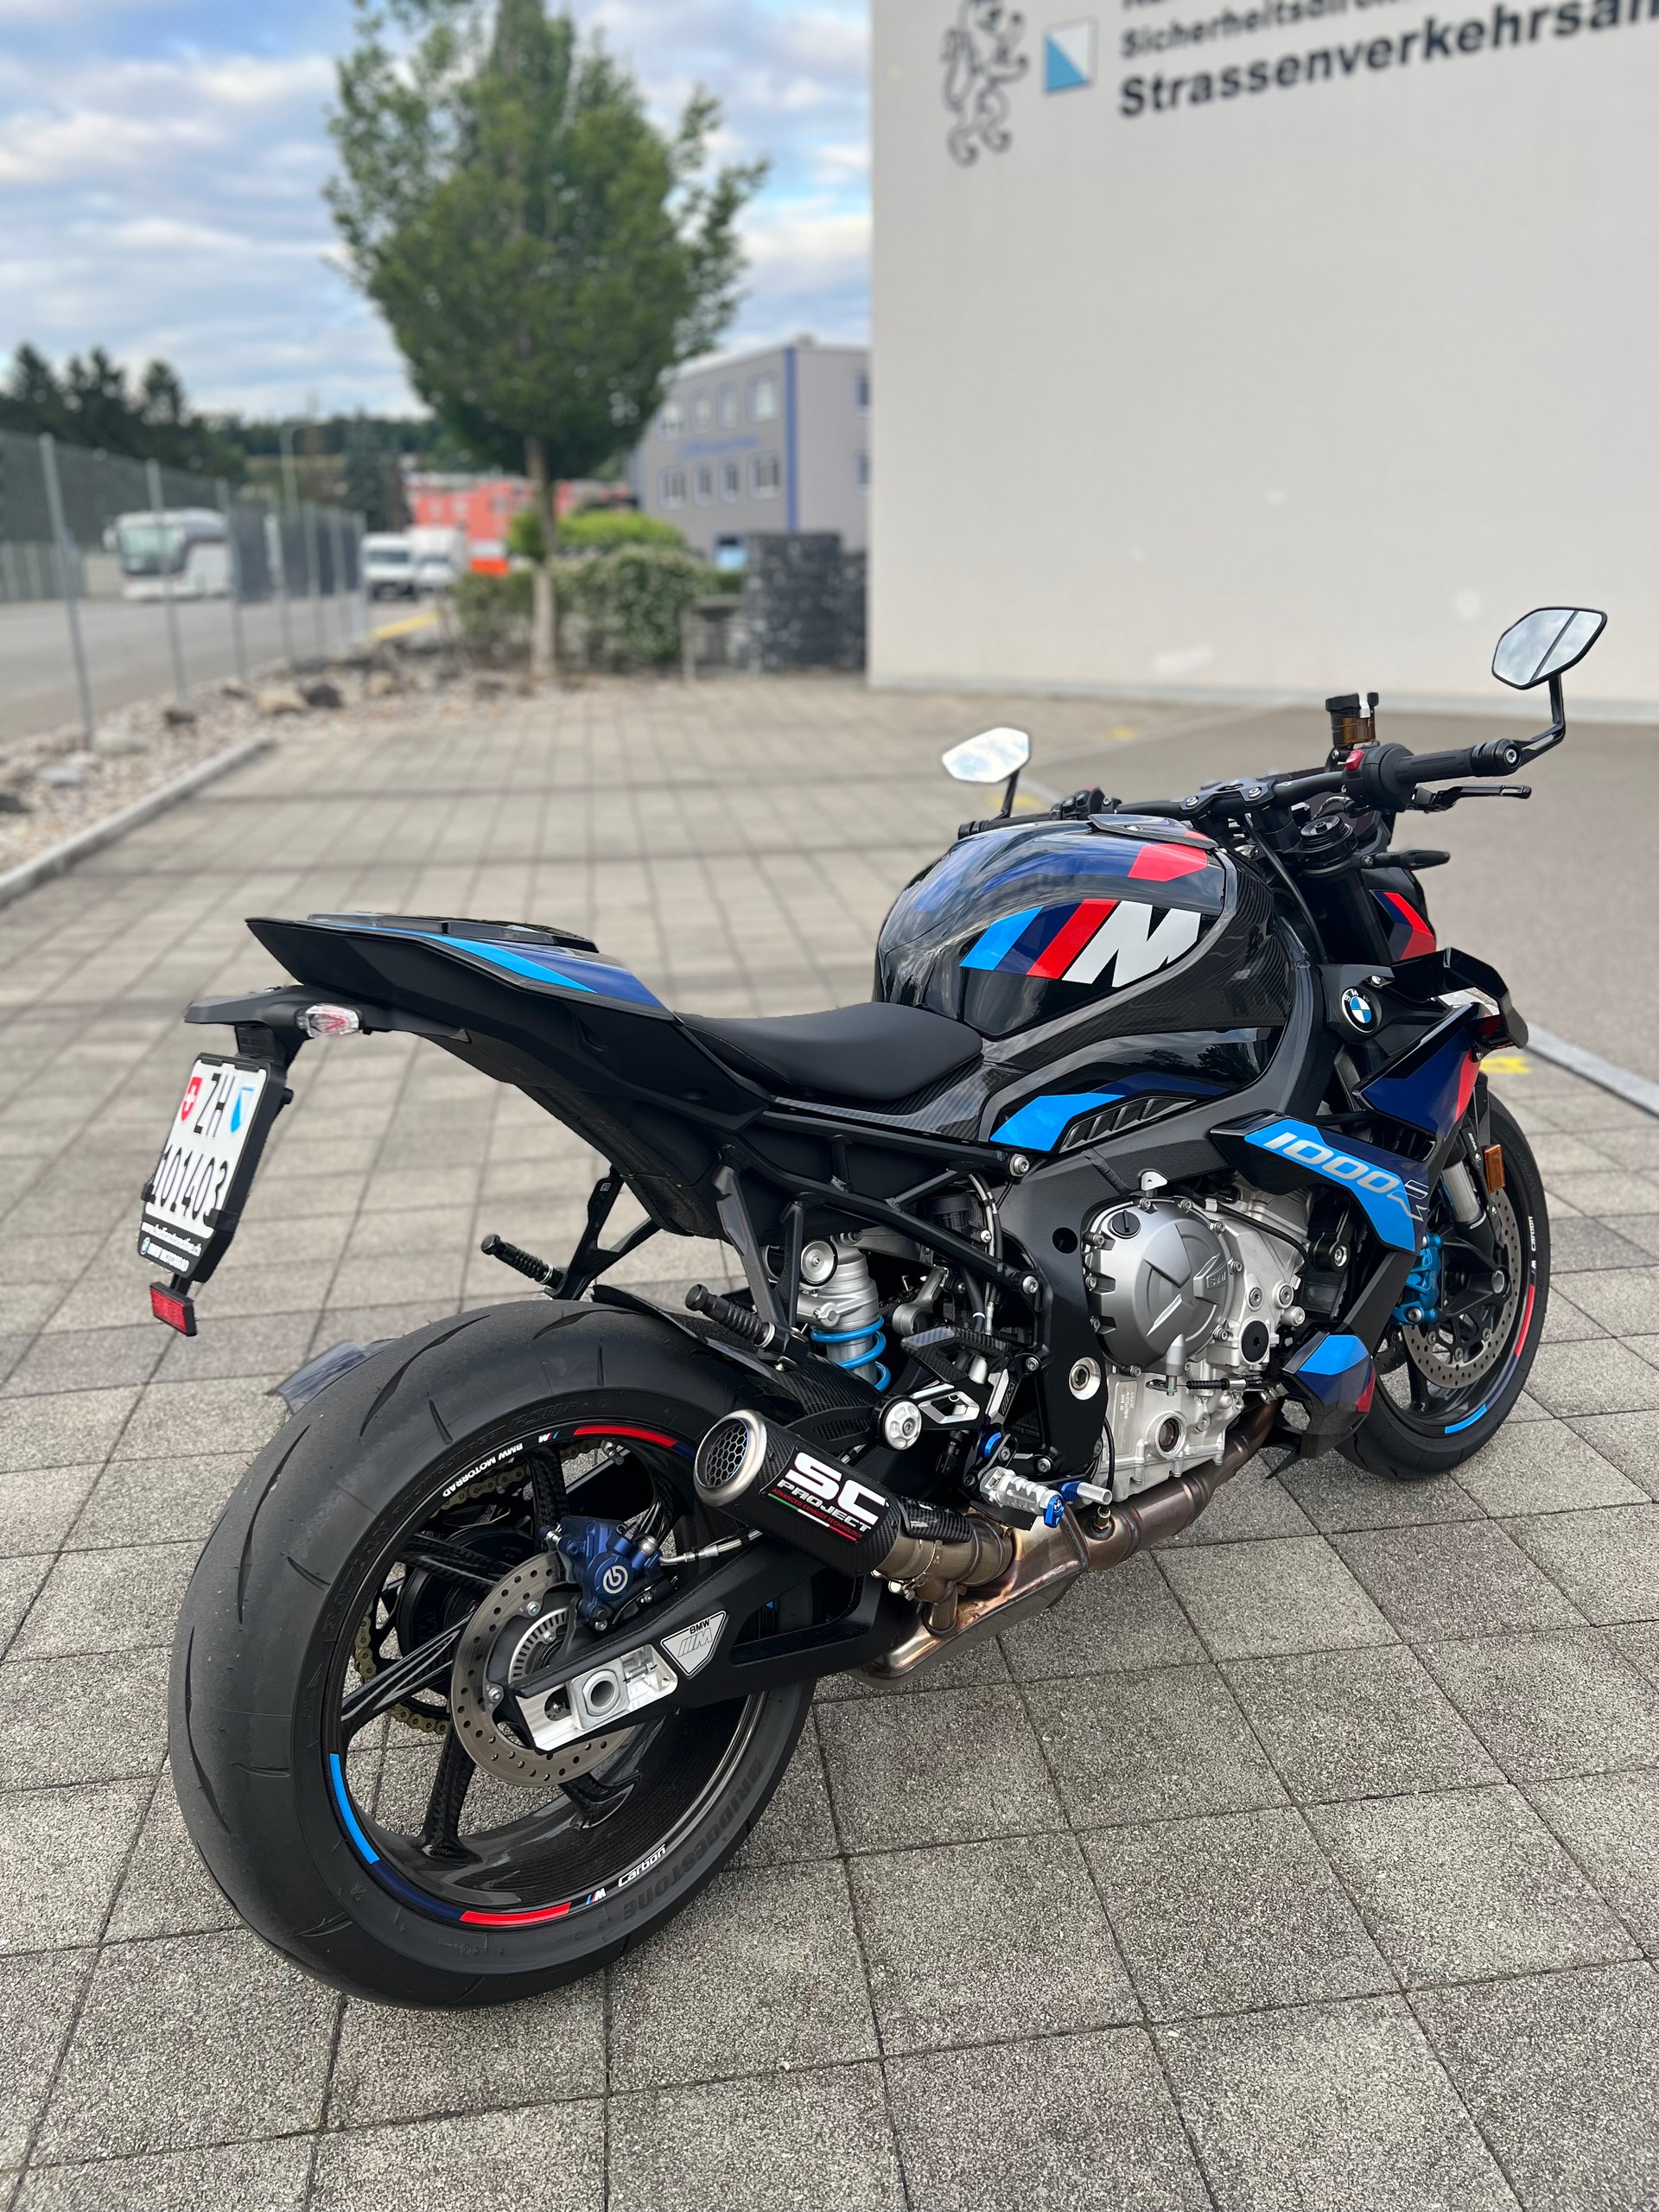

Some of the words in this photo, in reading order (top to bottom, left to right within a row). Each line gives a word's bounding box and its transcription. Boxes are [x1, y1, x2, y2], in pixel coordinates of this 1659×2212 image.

[194, 1072, 237, 1138] ZH
[150, 1143, 228, 1227] 101403
[442, 1455, 497, 1498] MOTORRAD
[498, 1442, 524, 1462] BMW
[777, 1478, 872, 1533] PROJECT
[785, 1452, 887, 1526] SC
[689, 1618, 710, 1635] BMW
[617, 1842, 667, 1888] Carbon
